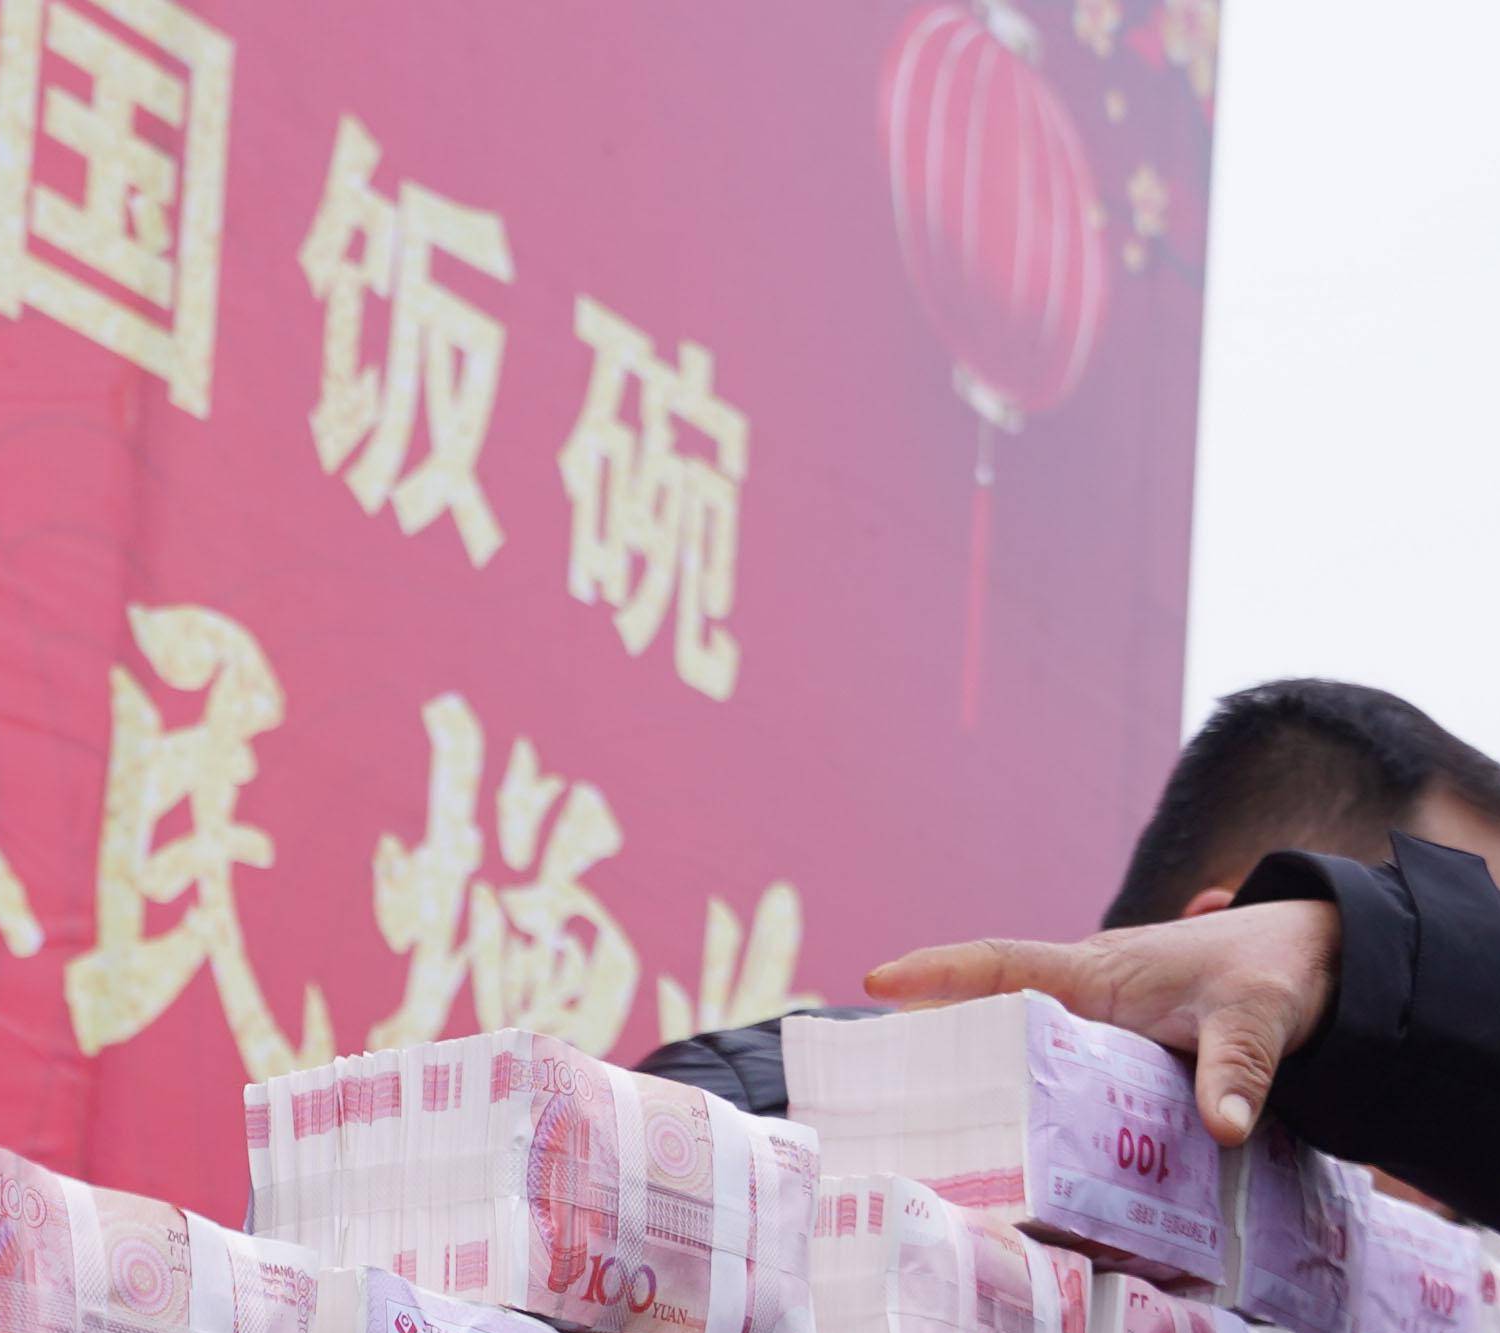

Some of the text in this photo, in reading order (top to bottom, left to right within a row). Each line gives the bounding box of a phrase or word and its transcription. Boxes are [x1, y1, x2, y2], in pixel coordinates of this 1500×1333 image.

[542, 1057, 594, 1100] 100
[1117, 1128, 1169, 1184] 100
[653, 1302, 688, 1325] YUAN
